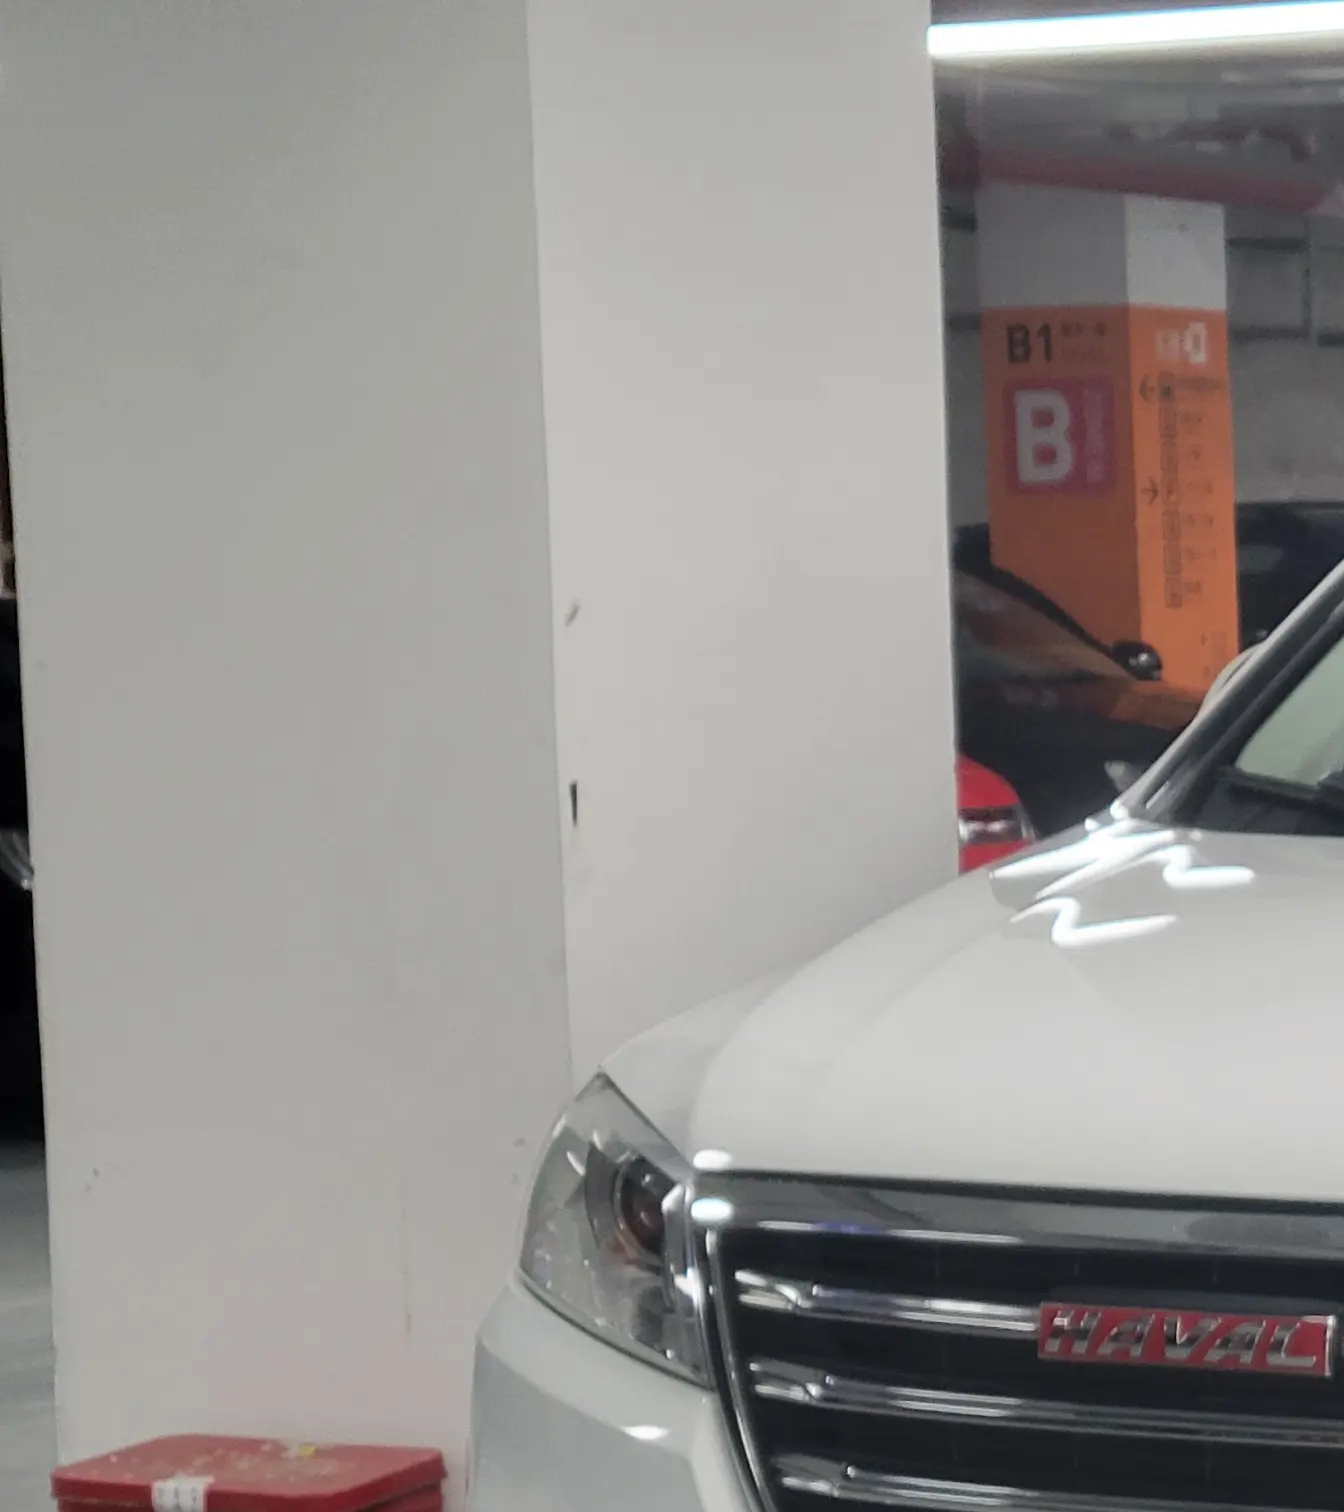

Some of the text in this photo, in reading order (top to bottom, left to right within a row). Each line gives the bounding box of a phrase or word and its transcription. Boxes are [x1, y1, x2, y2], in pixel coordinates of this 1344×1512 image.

[1007, 323, 1053, 364] B1
[1013, 389, 1075, 484] B
[1044, 1309, 1318, 1367] HAVAL
